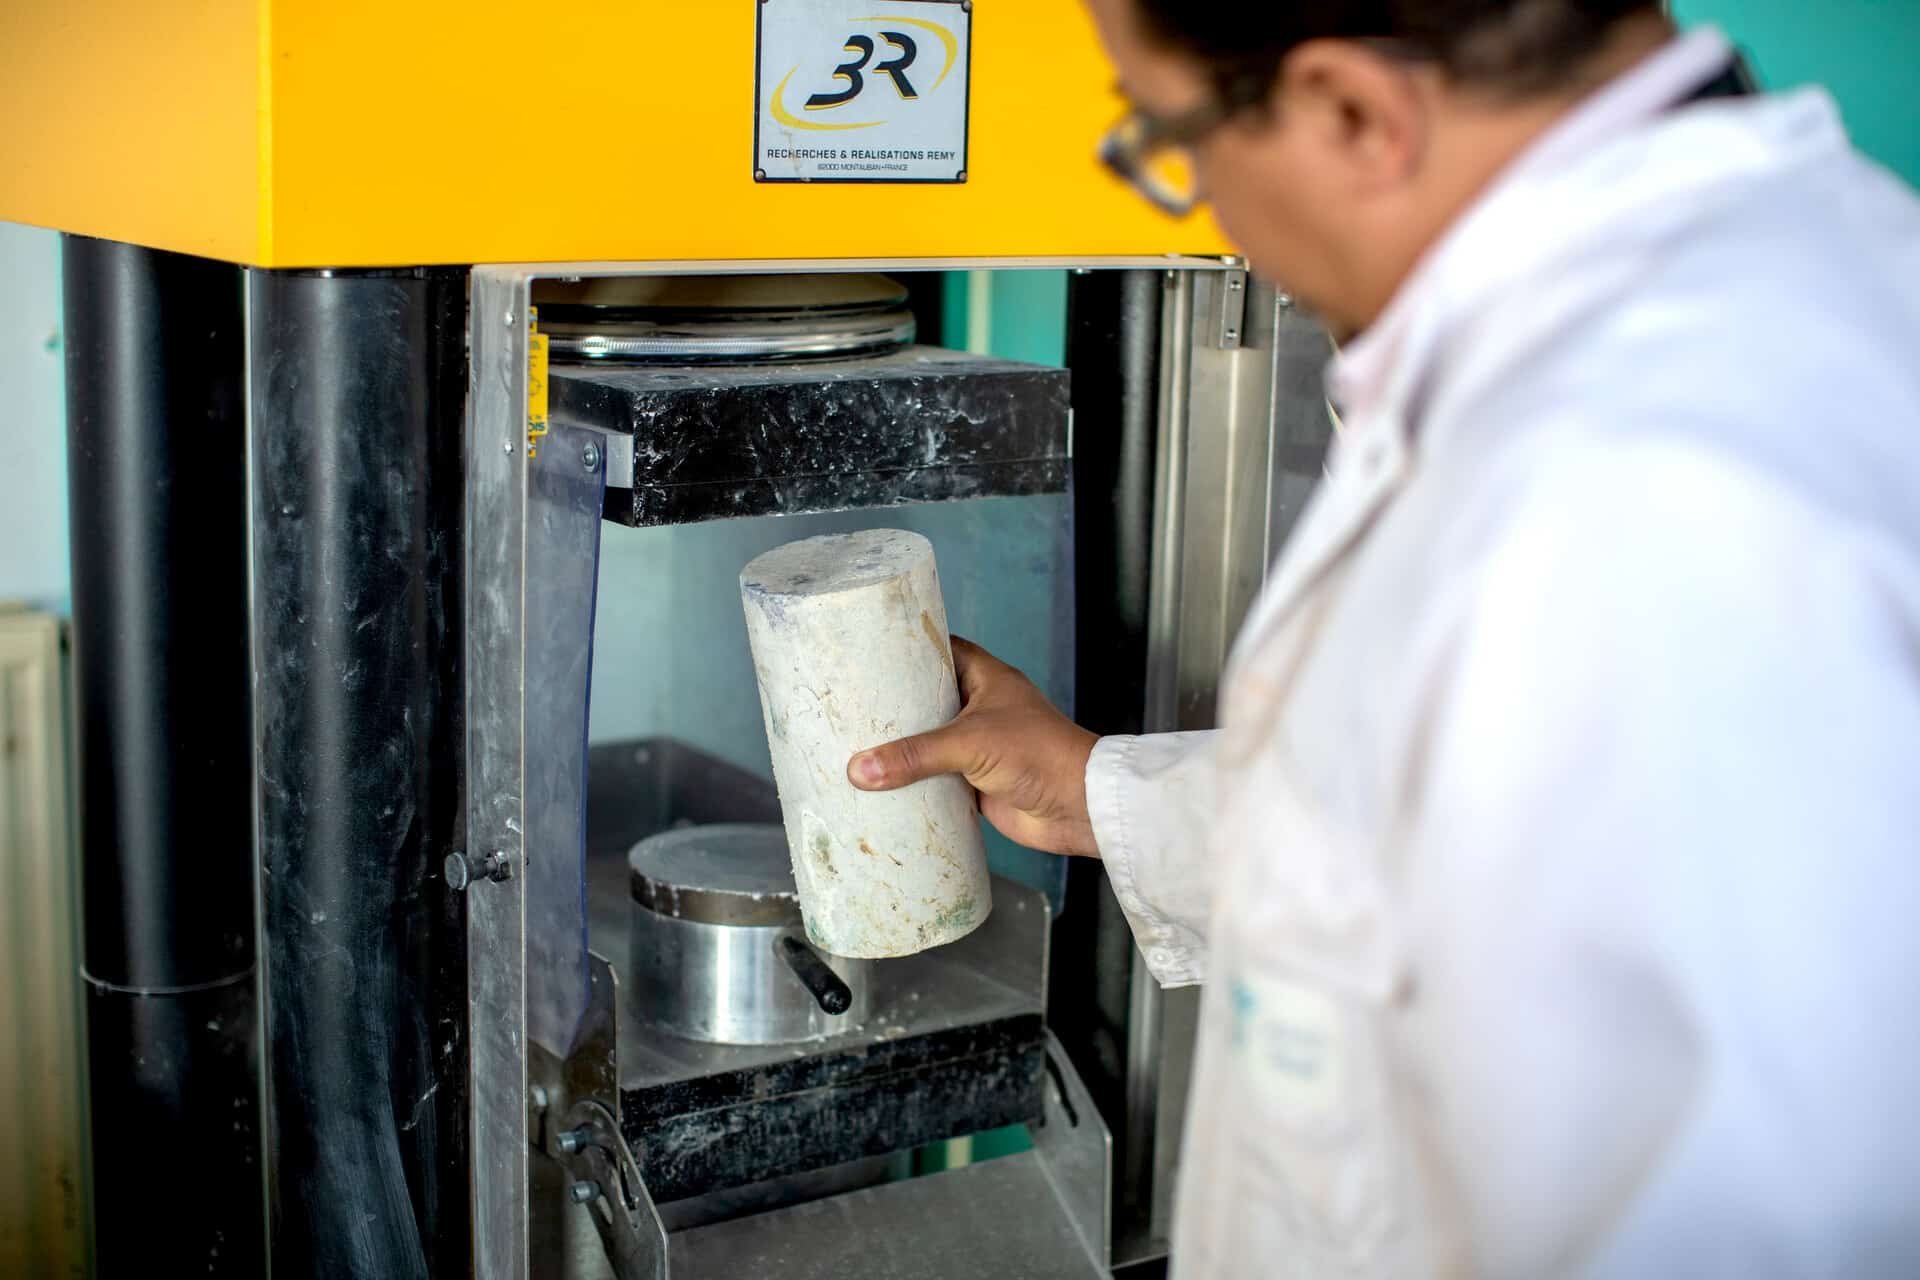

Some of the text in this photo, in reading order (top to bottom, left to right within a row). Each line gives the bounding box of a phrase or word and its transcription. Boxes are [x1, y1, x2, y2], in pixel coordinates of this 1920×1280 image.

[804, 31, 919, 111] 3R
[767, 149, 956, 160] RECHERCHES & REALISATIONS REMY
